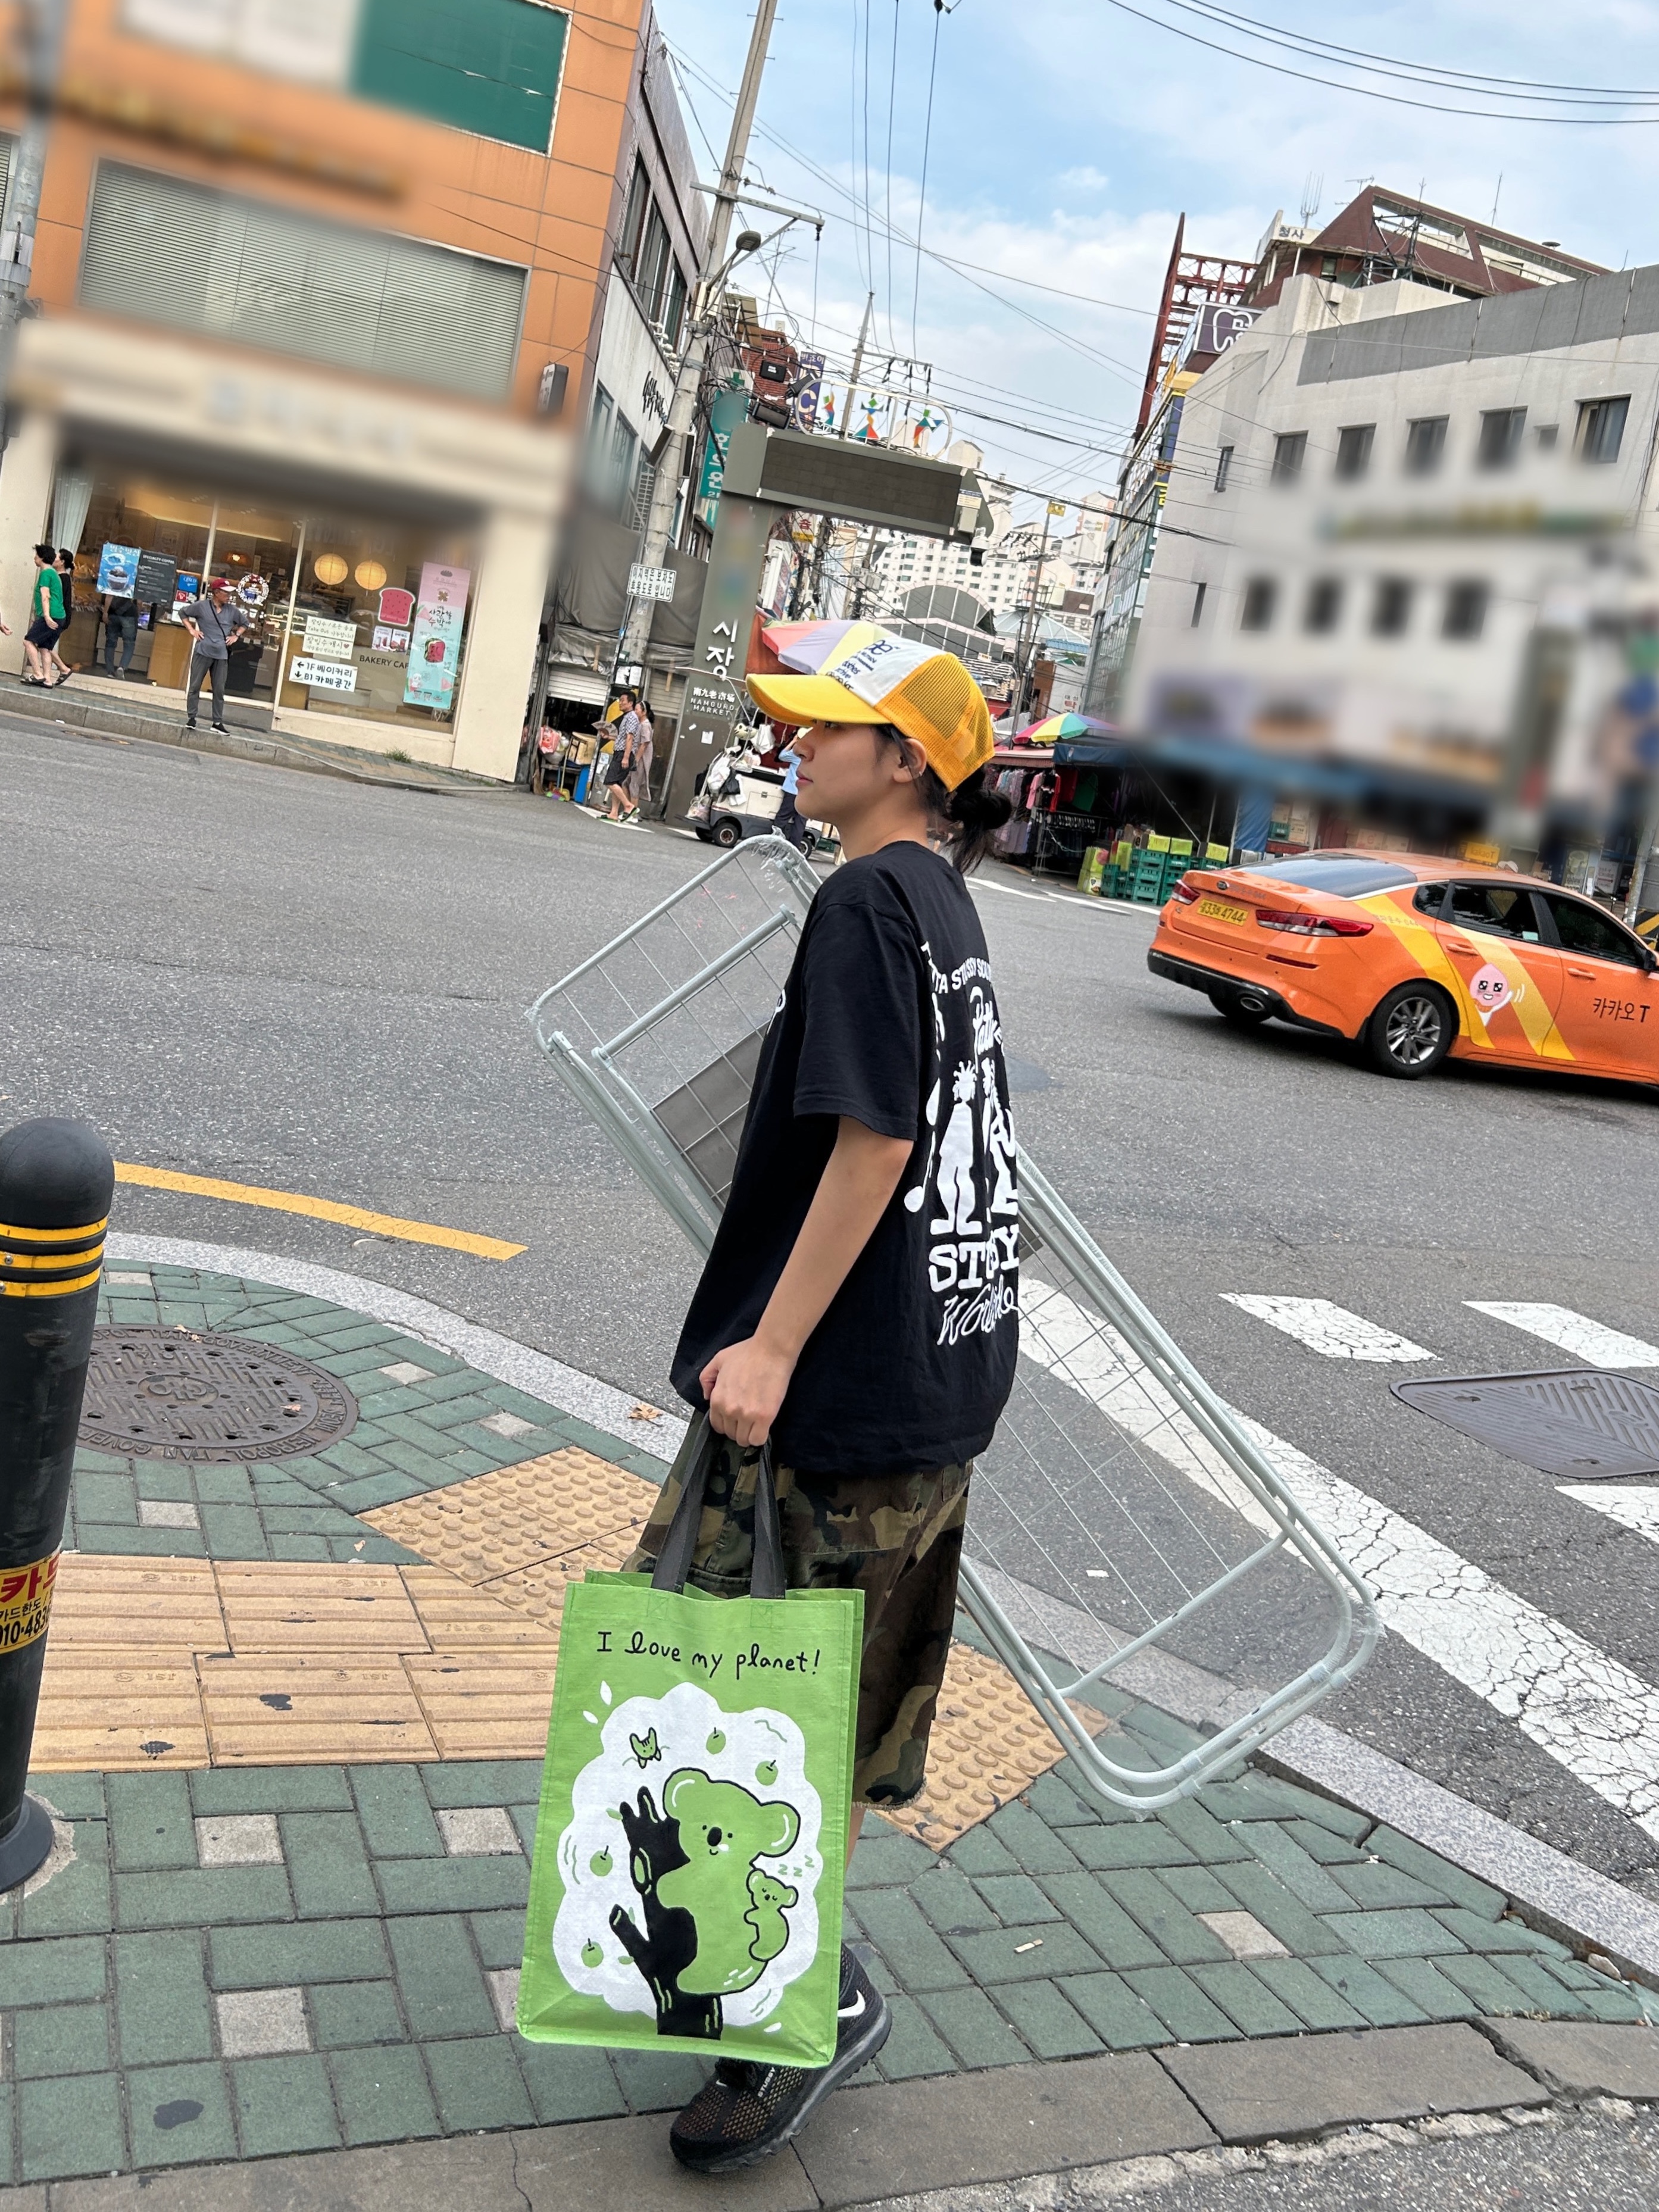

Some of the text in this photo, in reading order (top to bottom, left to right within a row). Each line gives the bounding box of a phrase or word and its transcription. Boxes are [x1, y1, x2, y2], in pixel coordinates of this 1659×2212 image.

[656, 570, 673, 584] 보차도
[631, 580, 671, 598] 혼용도로 입니다
[705, 618, 739, 679] 시장
[359, 655, 409, 669] BAKERY CAF
[304, 673, 313, 681] B1
[307, 662, 352, 678] 1F 베이커리
[690, 697, 735, 711] NAMGURO
[693, 704, 730, 716] MARKET
[1592, 998, 1650, 1023] 카카오 T
[597, 1630, 820, 1680] I love my planet!
